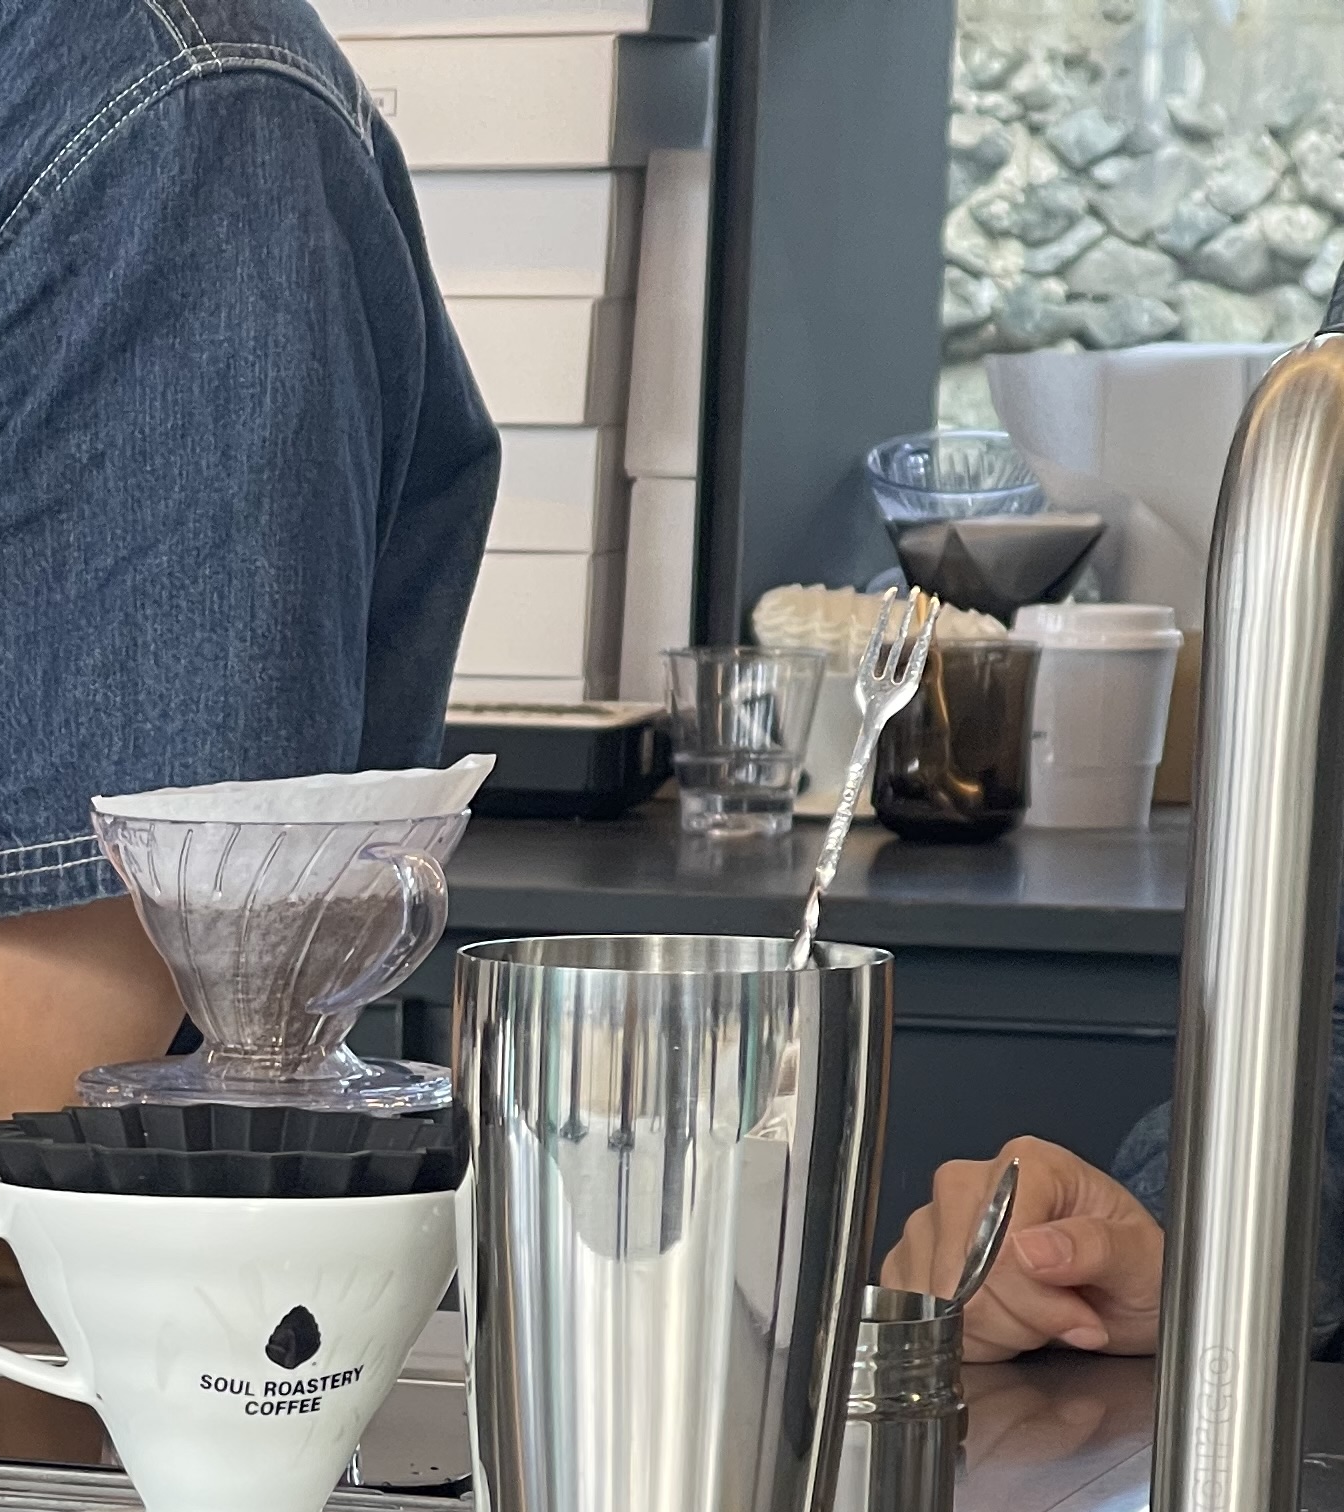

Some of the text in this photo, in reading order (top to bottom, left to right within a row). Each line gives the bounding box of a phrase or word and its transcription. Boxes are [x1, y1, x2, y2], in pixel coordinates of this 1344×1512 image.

[199, 1364, 364, 1398] SOUL ROASTERY
[244, 1397, 321, 1415] COFFEE
